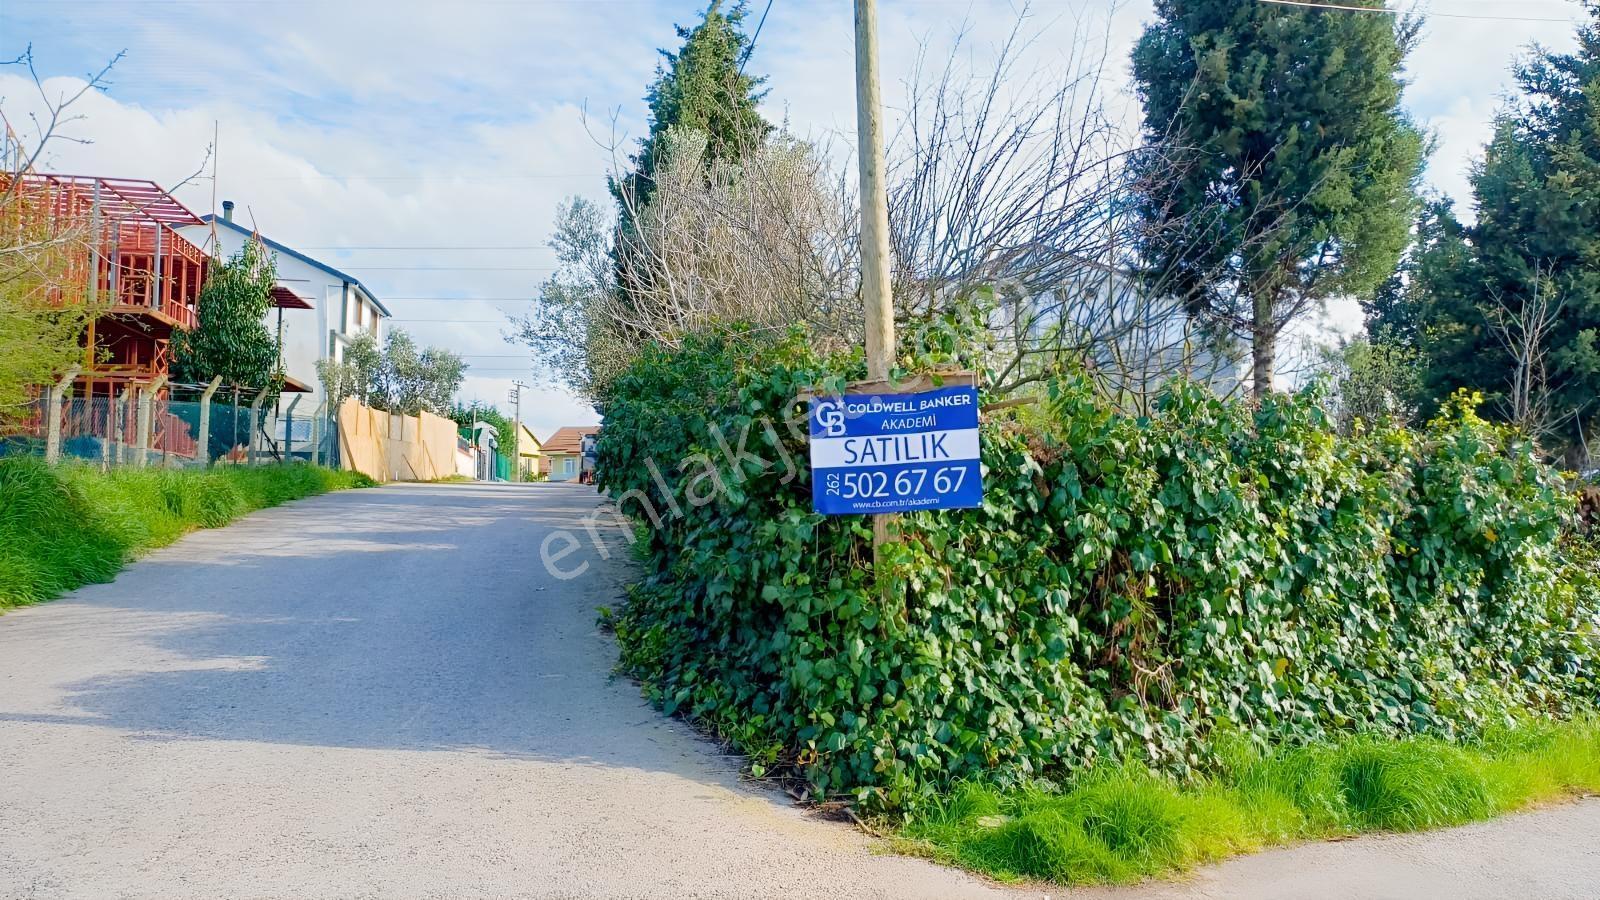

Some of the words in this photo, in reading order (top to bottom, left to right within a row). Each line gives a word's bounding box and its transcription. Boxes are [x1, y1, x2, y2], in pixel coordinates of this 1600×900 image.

[848, 402, 917, 414] COLDWELL
[920, 394, 971, 411] BANKER
[844, 433, 950, 464] SATILIK
[826, 472, 840, 496] 262
[842, 471, 890, 499] 502
[894, 469, 928, 496] 67
[933, 466, 967, 494] 67
[852, 498, 940, 509] www.cb.com.tr/akademi
